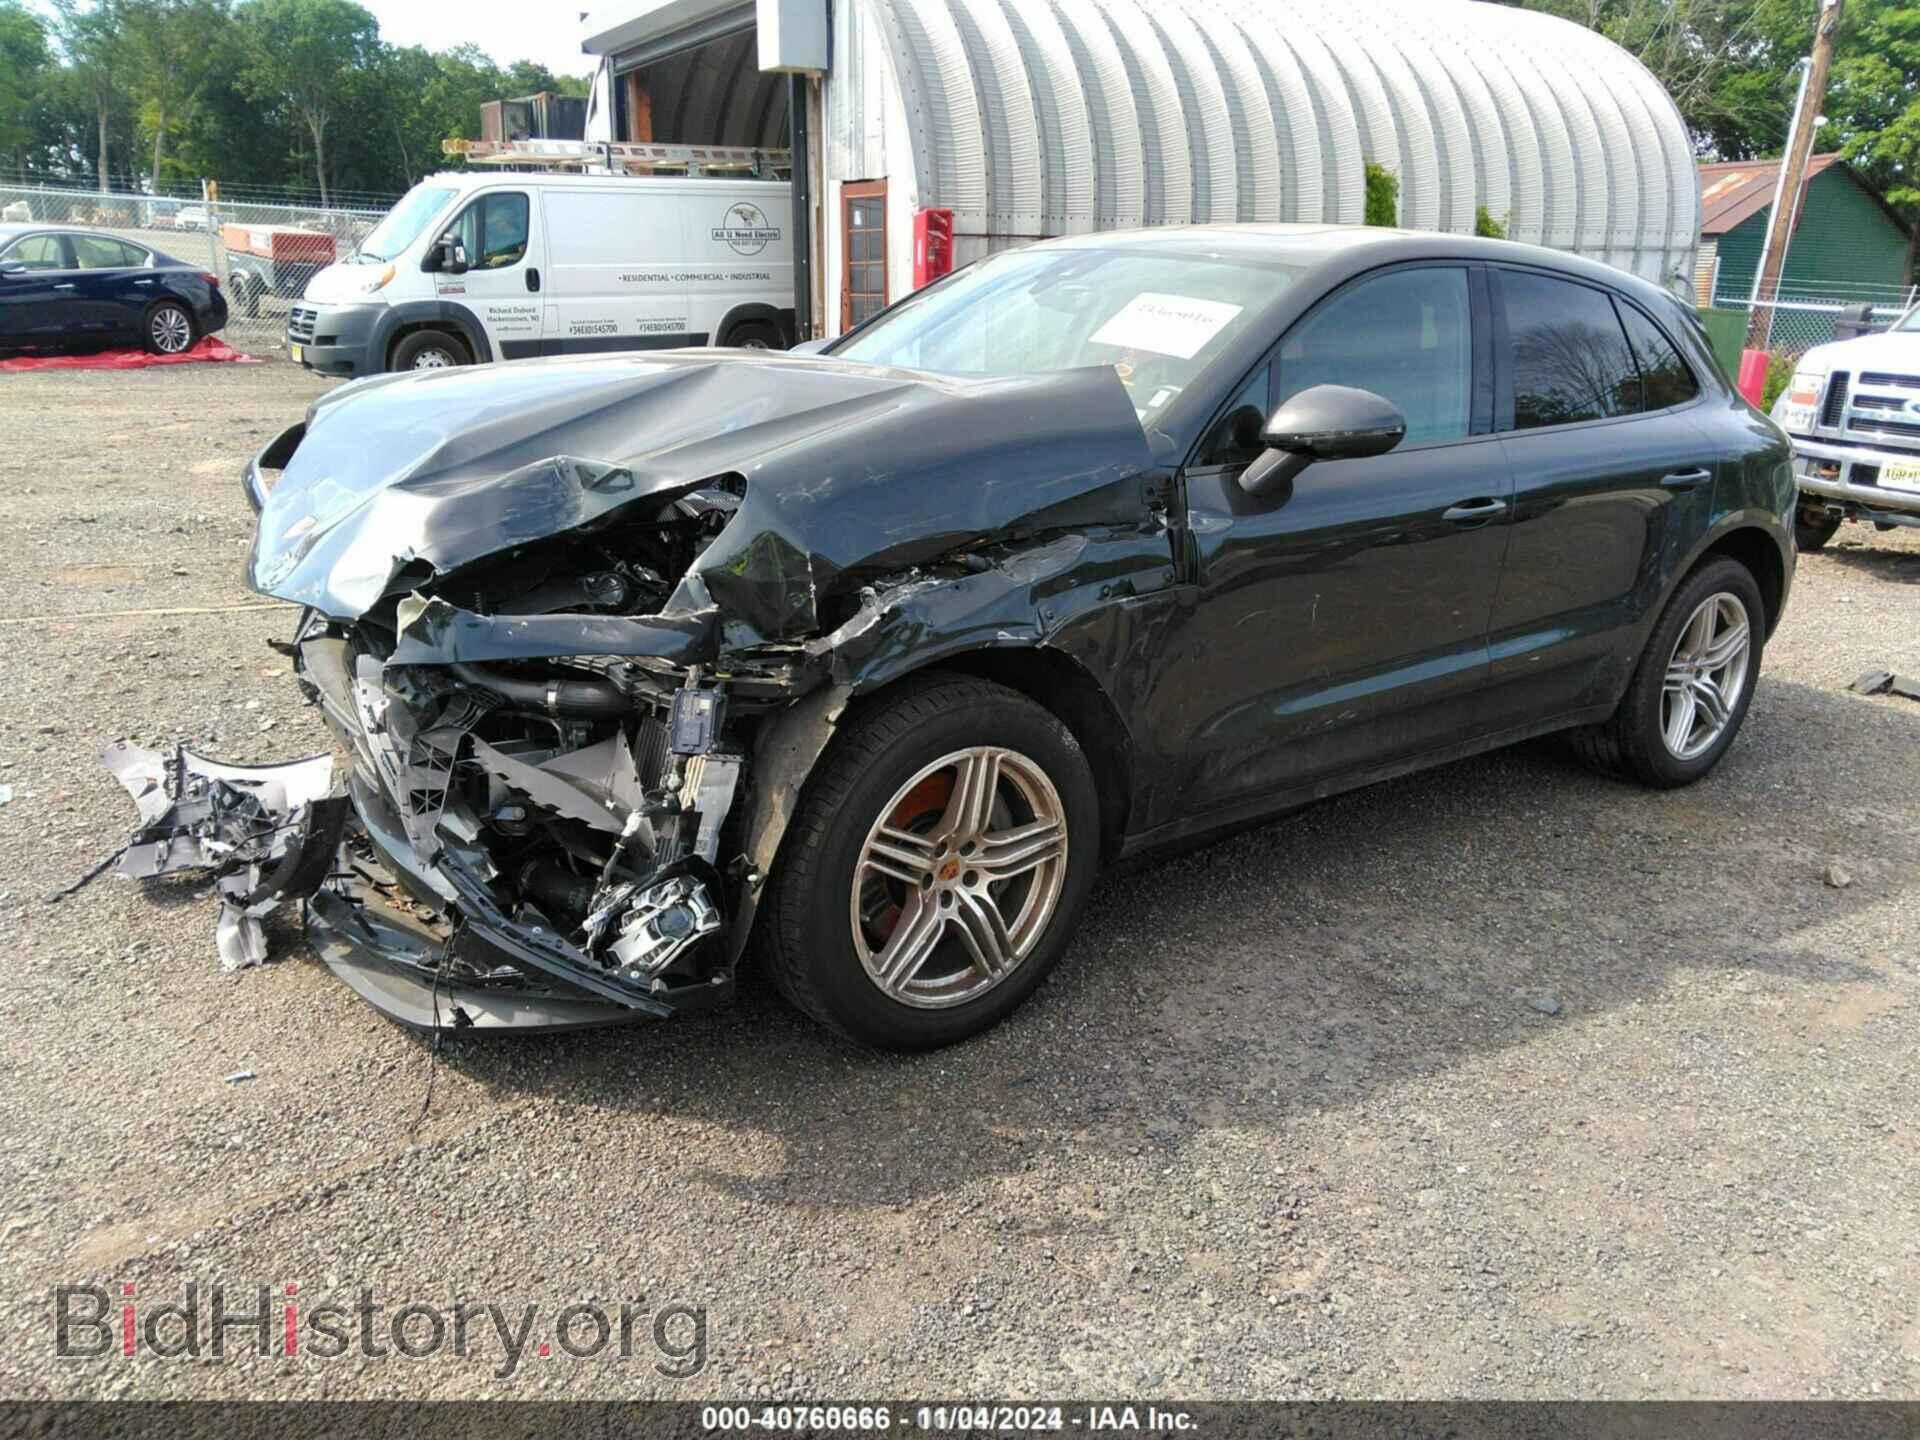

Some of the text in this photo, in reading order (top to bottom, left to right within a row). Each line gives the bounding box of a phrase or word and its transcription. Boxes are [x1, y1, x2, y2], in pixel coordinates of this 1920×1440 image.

[735, 230, 753, 238] Need
[754, 230, 778, 238] Electric
[622, 271, 771, 282] RESIDENTIAL COMMERCIAL INDUSTRIAL
[488, 306, 512, 314] Richard
